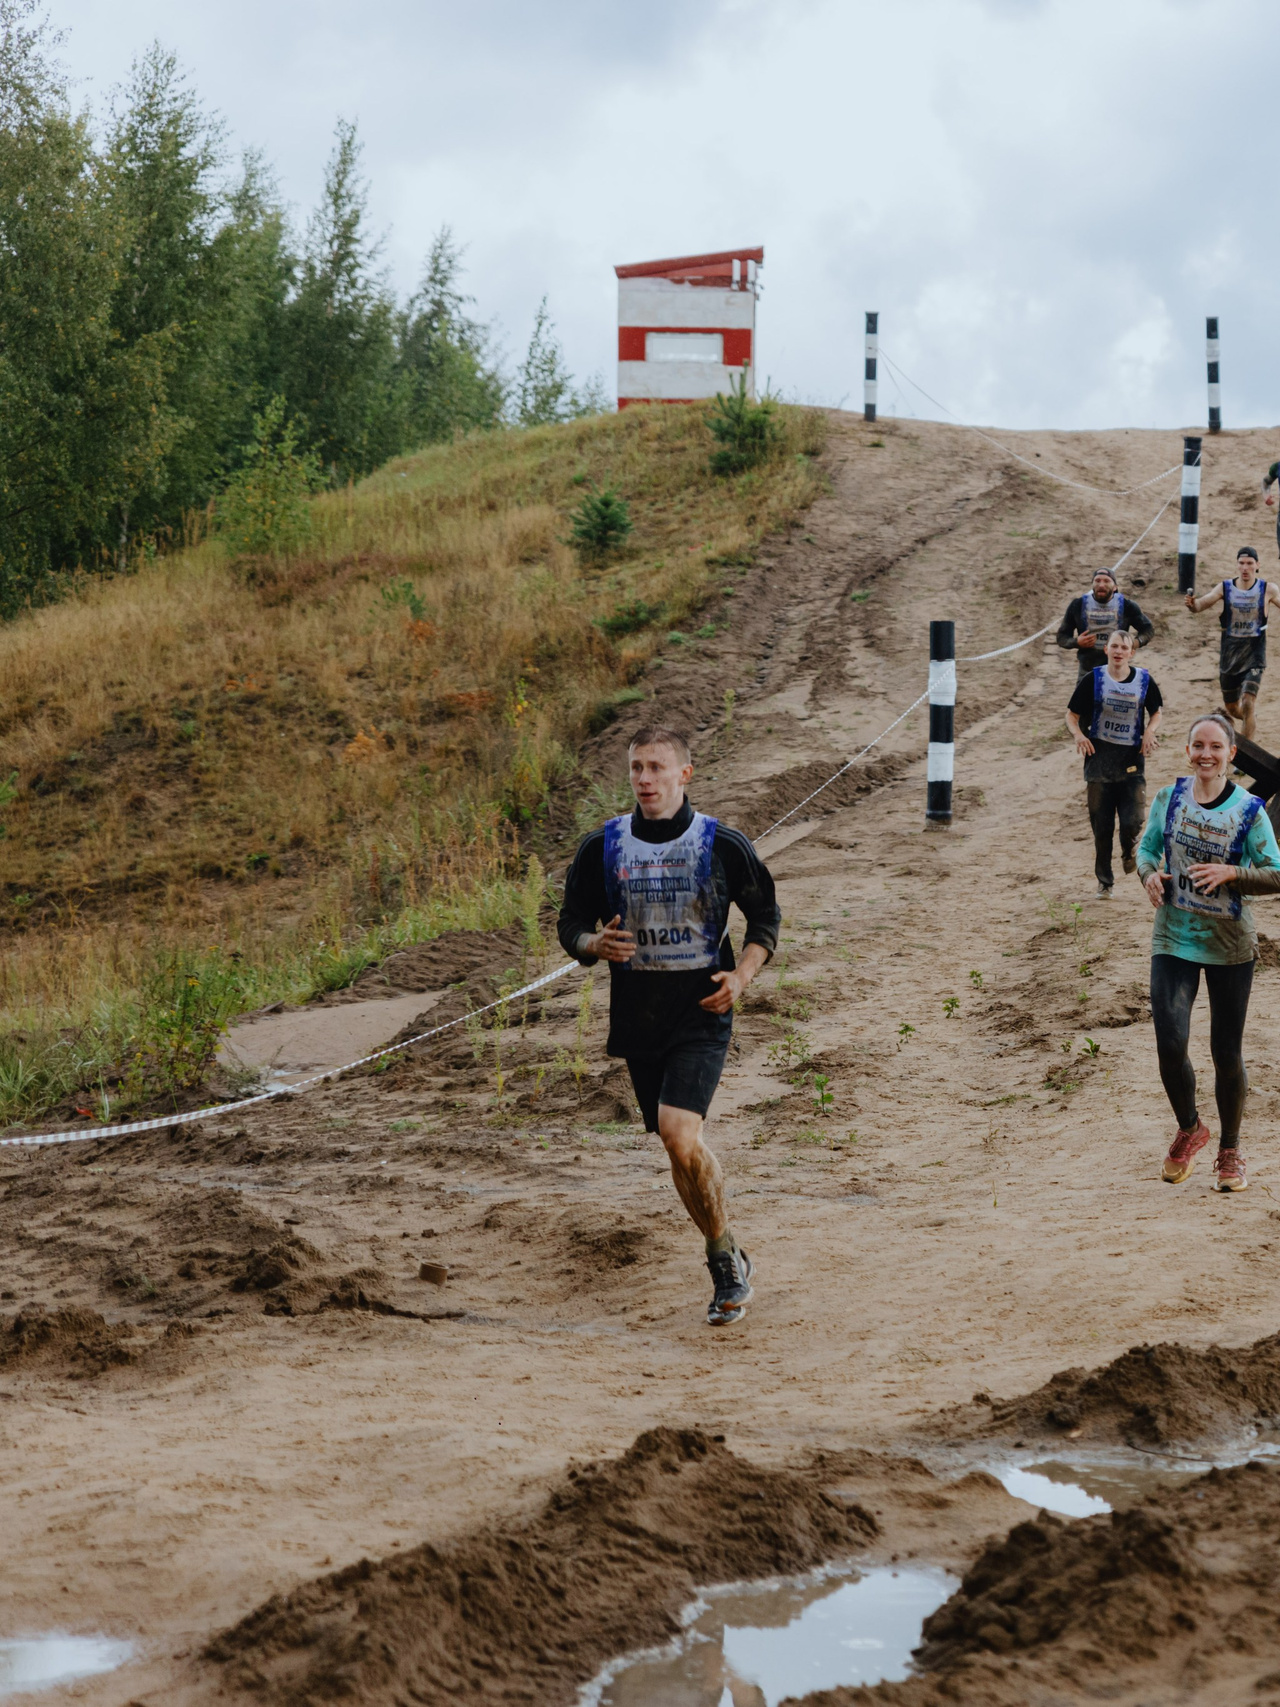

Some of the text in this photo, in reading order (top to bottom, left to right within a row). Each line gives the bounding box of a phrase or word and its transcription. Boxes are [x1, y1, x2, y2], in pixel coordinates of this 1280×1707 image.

[1104, 720, 1130, 733] 01203
[1204, 825, 1228, 834] ГЕРОЕВ
[630, 859, 655, 867] ГОНКА
[630, 879, 689, 890] КОМАНДНЫЙ
[647, 891, 674, 902] СТАРТ
[637, 927, 692, 946] 01204
[653, 953, 697, 961] ГАЗПРОМБАНК
